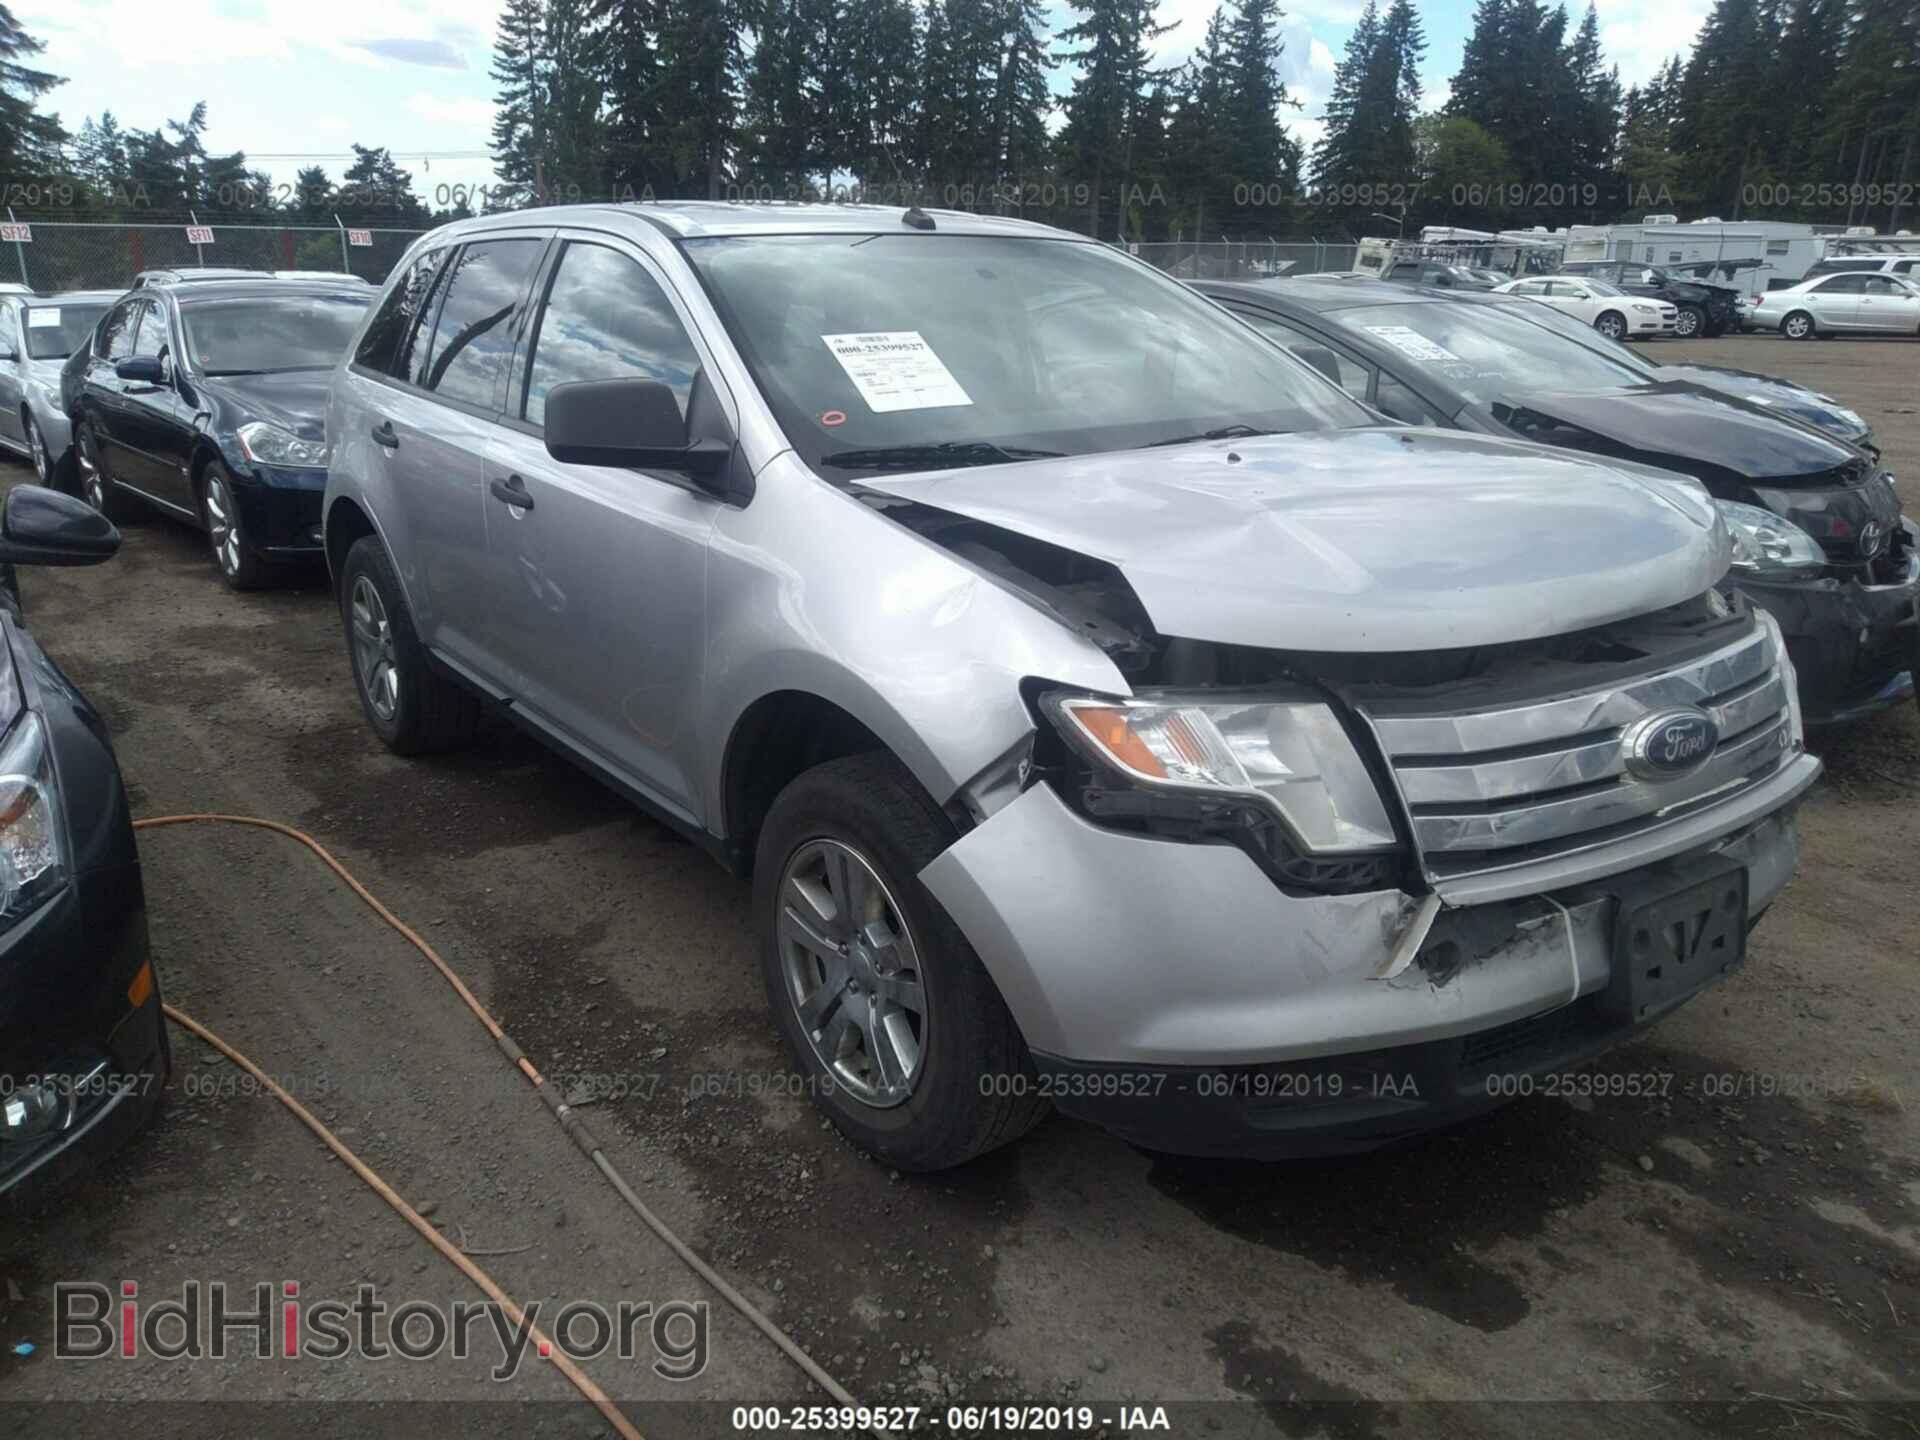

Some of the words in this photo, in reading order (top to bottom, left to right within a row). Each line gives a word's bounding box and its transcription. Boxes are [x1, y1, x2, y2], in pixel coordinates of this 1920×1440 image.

[2, 225, 30, 240] SF12
[190, 228, 212, 241] SF11
[1664, 722, 1706, 762] Ford
